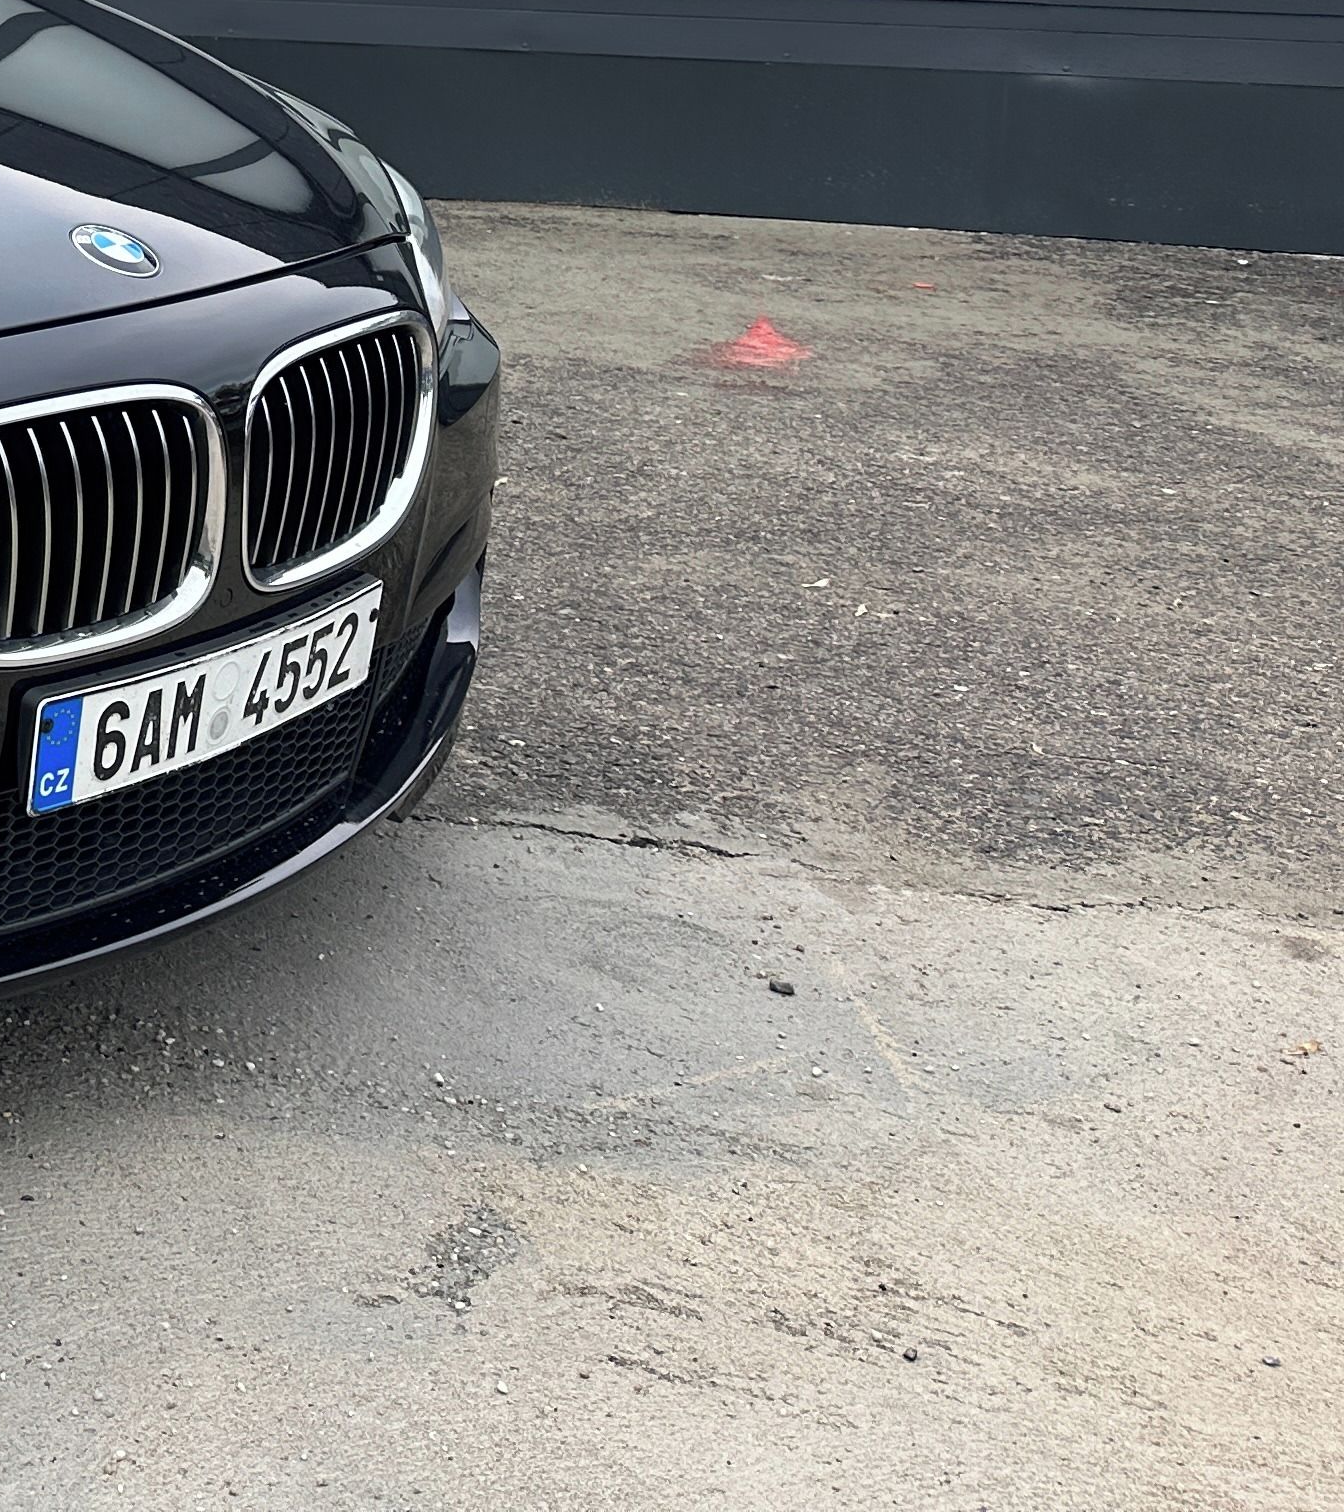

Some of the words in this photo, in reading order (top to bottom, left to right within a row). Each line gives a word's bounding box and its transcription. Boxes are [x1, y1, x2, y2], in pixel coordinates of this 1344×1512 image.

[92, 673, 207, 782] 6AM
[242, 611, 359, 727] 4552
[39, 767, 70, 798] CZ
